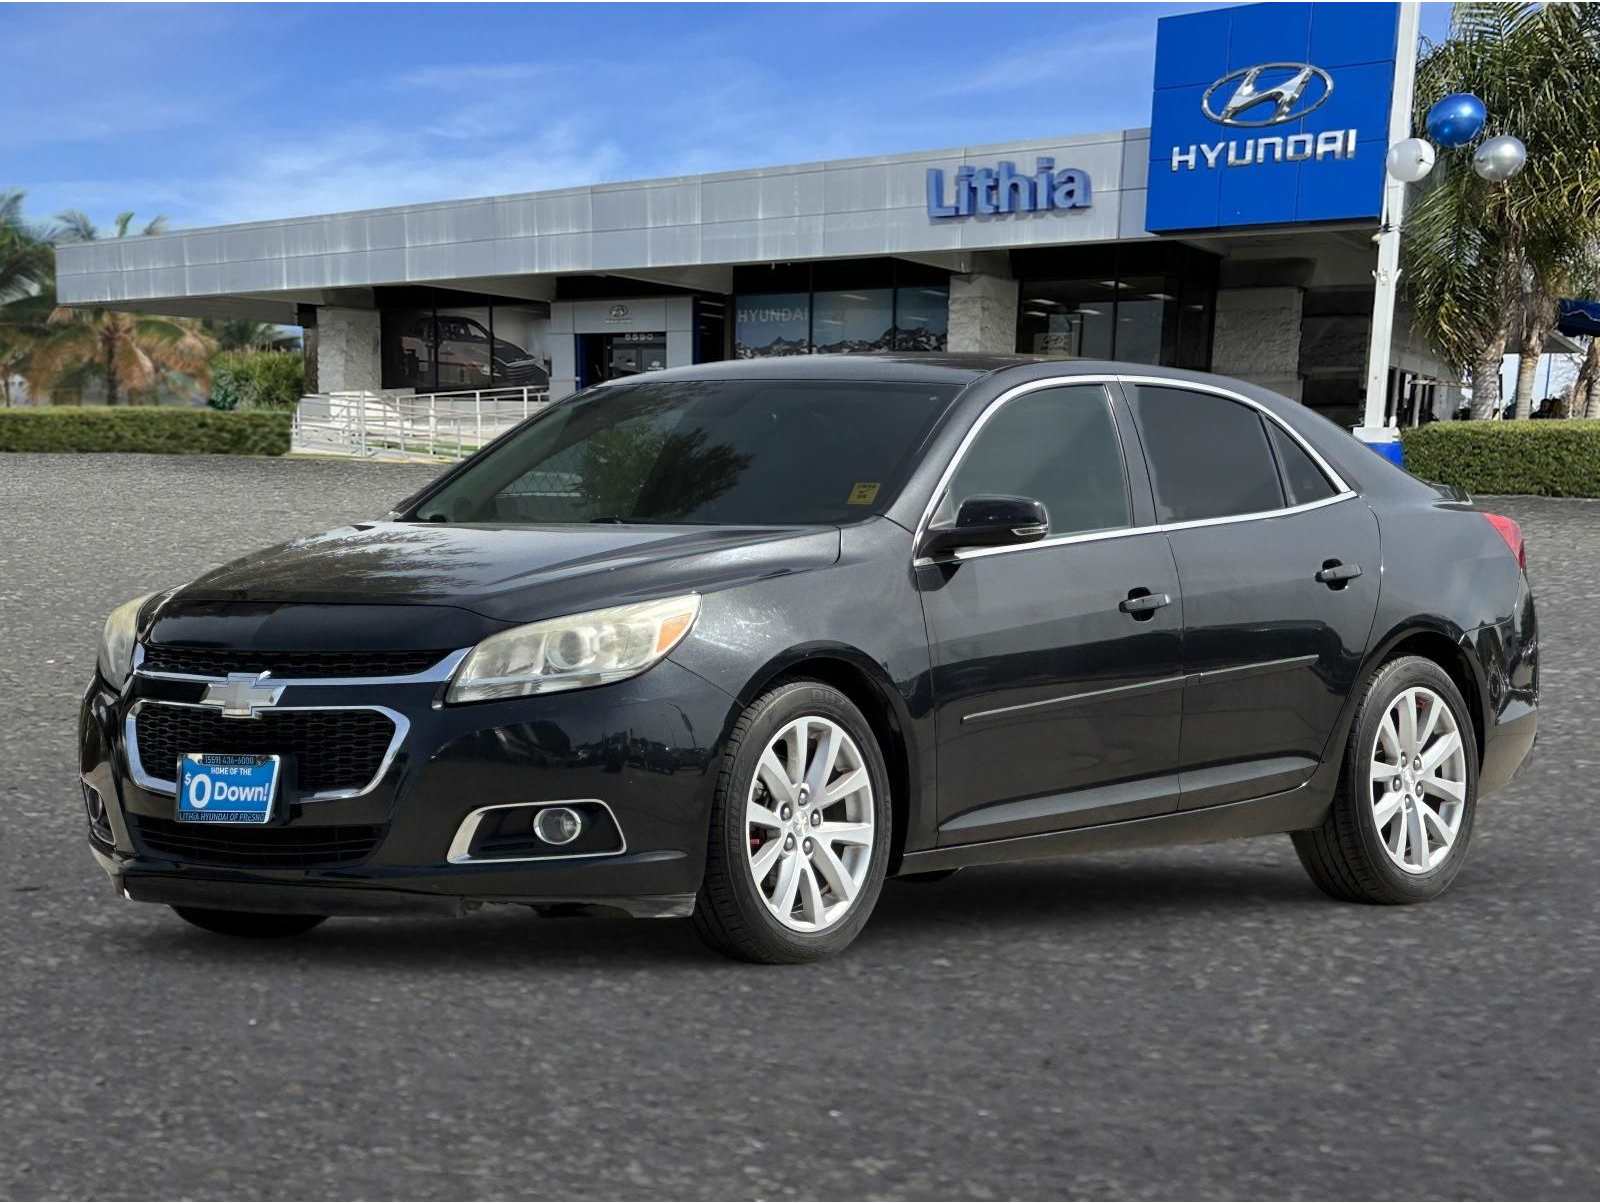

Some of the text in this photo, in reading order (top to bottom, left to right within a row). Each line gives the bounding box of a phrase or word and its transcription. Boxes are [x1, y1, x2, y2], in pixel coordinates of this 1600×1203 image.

[1171, 128, 1358, 172] HYUNDAI
[926, 156, 1093, 218] Lithia
[737, 307, 809, 323] HYUNDAI
[210, 767, 252, 776] HOME OF THE
[213, 781, 270, 802] Down!
[200, 812, 229, 821] HYUNDAI
[230, 812, 239, 821] OF
